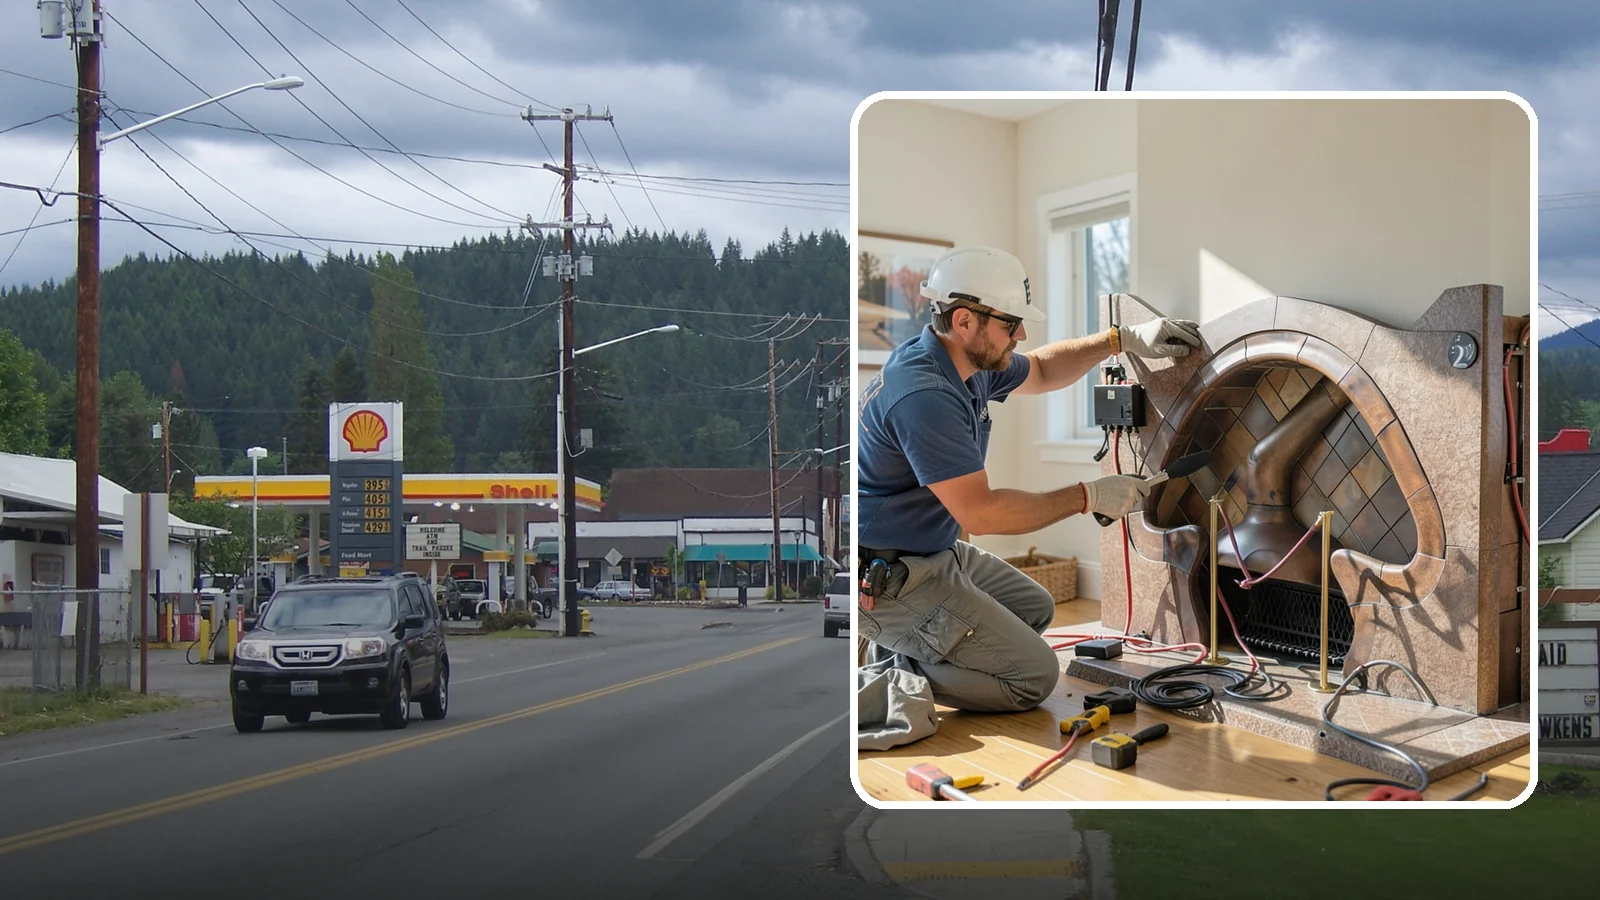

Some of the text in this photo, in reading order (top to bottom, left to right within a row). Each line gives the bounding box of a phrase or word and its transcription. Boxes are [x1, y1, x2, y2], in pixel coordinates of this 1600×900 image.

[366, 480, 383, 490] 395
[490, 484, 547, 499] Shell
[366, 494, 383, 504] 405
[366, 508, 383, 518] 415
[366, 522, 383, 532] 429
